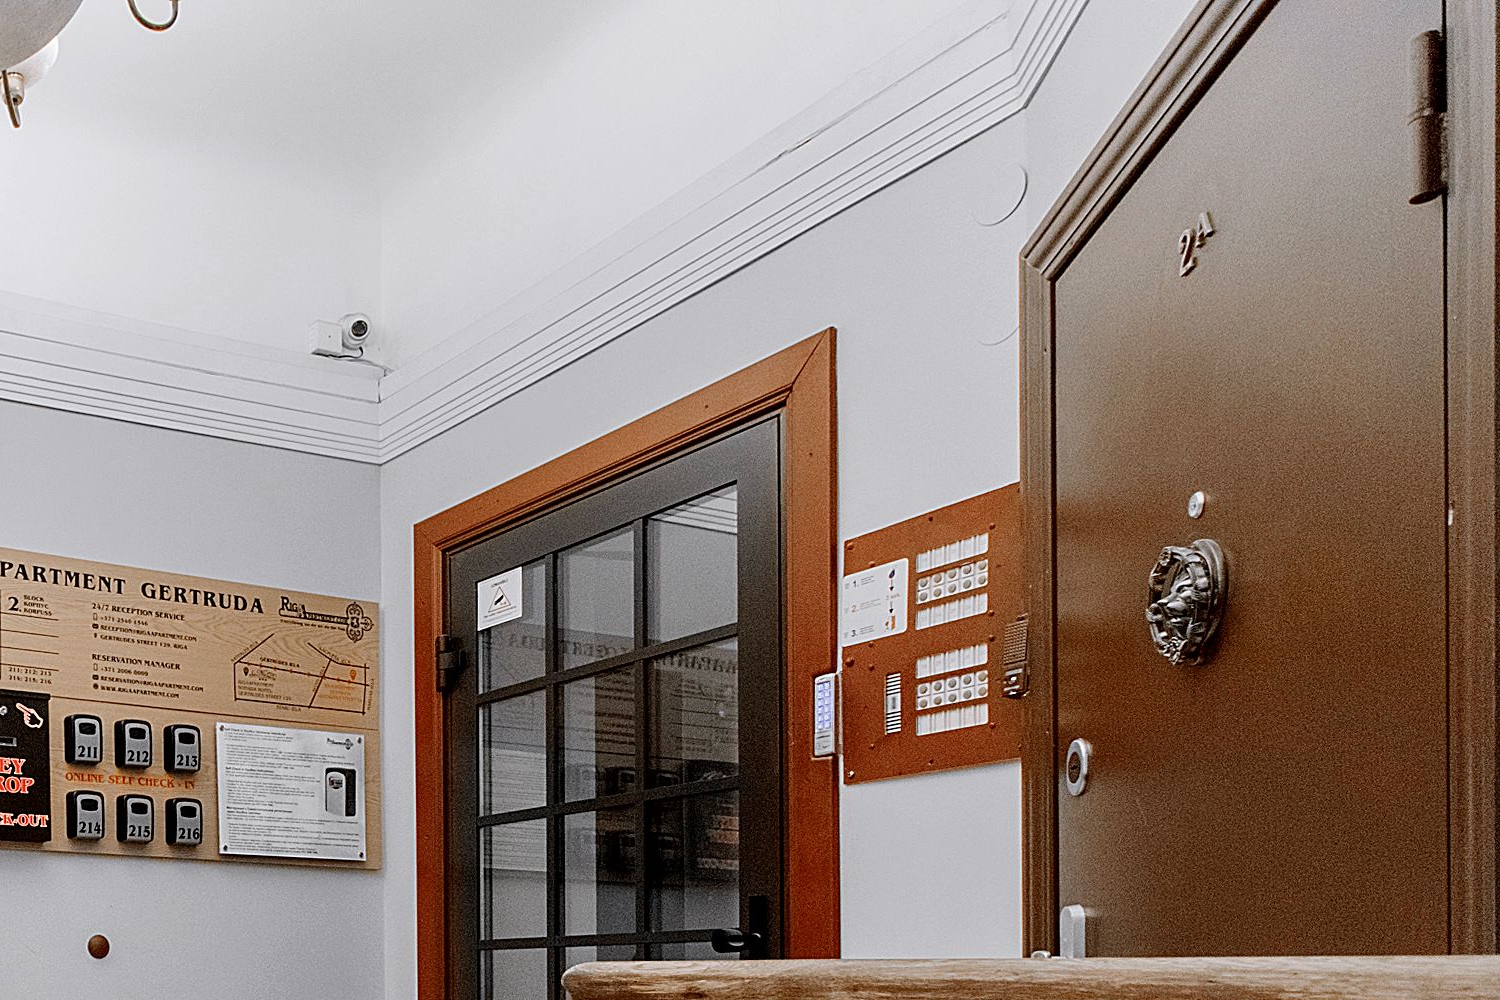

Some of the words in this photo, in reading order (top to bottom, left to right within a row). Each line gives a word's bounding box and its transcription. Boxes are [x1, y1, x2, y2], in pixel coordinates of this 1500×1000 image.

[8, 596, 22, 612] 2.
[141, 583, 264, 614] GERTRUDA
[92, 602, 109, 611] 24/7
[111, 605, 153, 616] RECEPTION
[155, 611, 185, 621] SERVICE
[91, 653, 141, 665] RESERVATION
[144, 659, 181, 670] MANAGER
[77, 745, 98, 759] 211
[127, 750, 149, 763] 212
[176, 754, 198, 767] 213
[65, 772, 104, 784] ONLINE
[108, 775, 135, 786] SELF
[138, 777, 174, 789] CHECK
[184, 780, 196, 790] IN
[78, 821, 102, 834] 214
[129, 825, 151, 837] 215
[178, 828, 200, 840] 216
